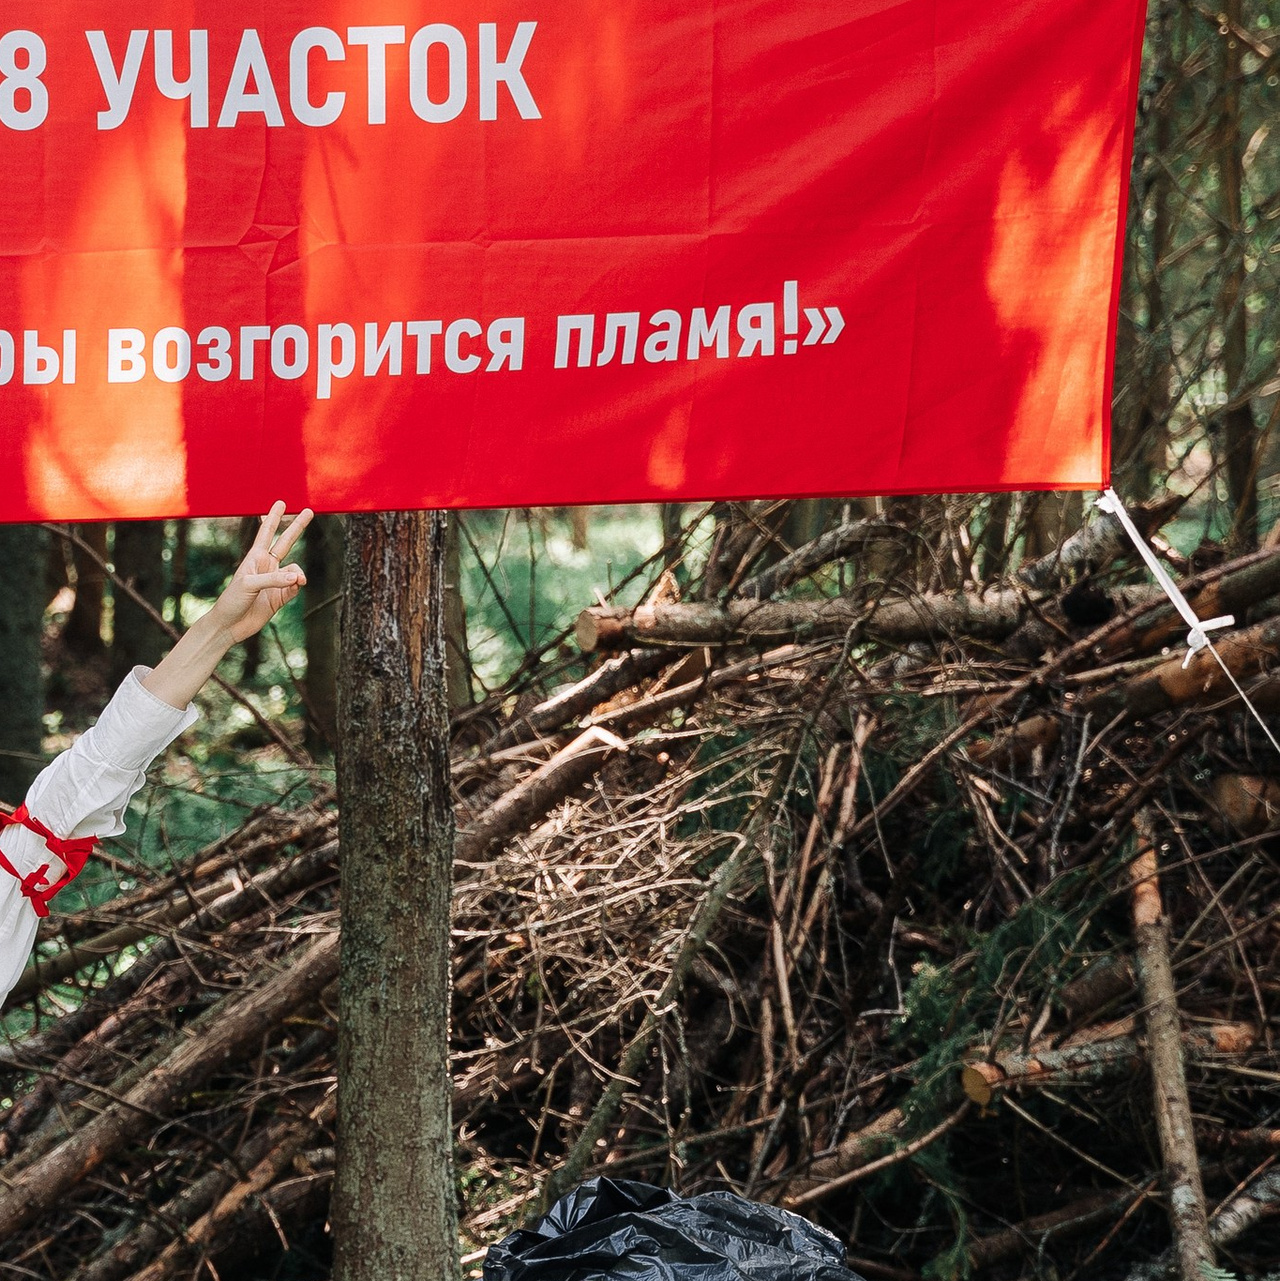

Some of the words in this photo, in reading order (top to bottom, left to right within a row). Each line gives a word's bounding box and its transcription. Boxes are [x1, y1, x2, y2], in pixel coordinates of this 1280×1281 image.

[85, 21, 543, 131] УЧАСТОК
[107, 316, 524, 400] возгорится
[554, 280, 846, 369] пламя!»
